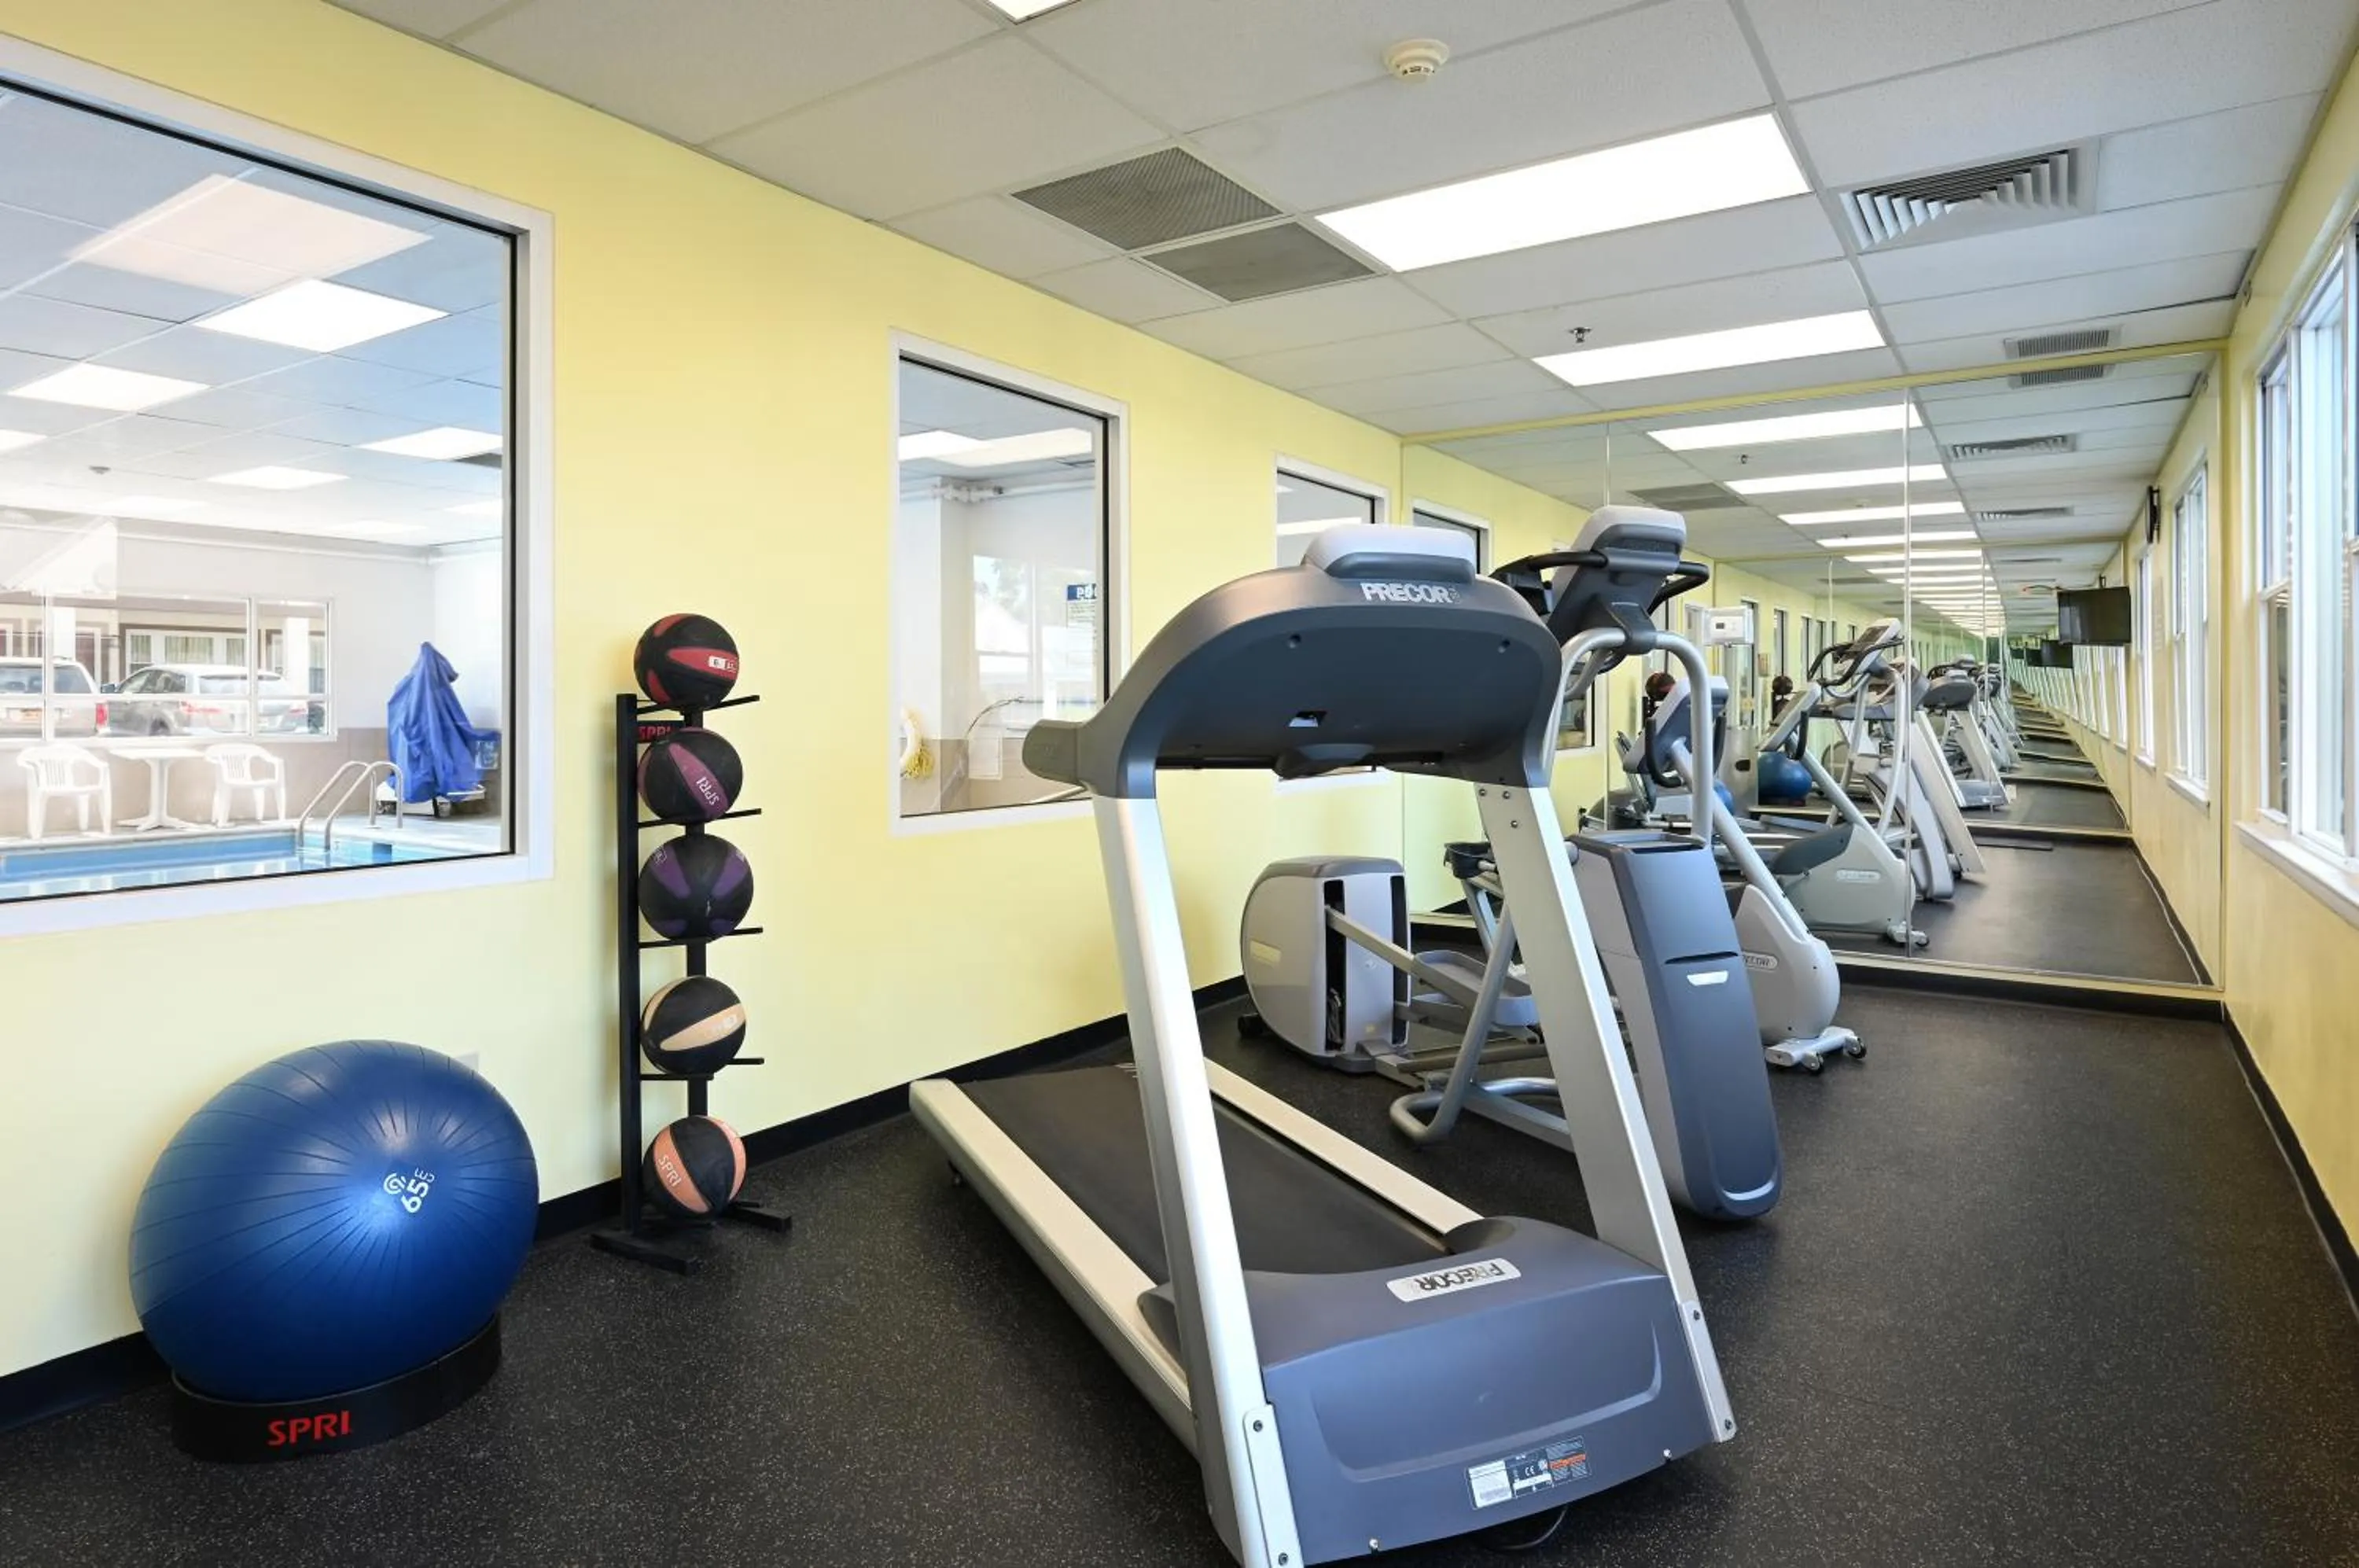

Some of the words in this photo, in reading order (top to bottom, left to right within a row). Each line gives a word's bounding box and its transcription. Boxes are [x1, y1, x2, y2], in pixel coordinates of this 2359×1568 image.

[1360, 583, 1453, 603] PRECOR
[696, 776, 719, 805] SPRI
[657, 1154, 682, 1187] SPRI
[400, 1178, 429, 1213] 65
[266, 1410, 350, 1446] SPRI
